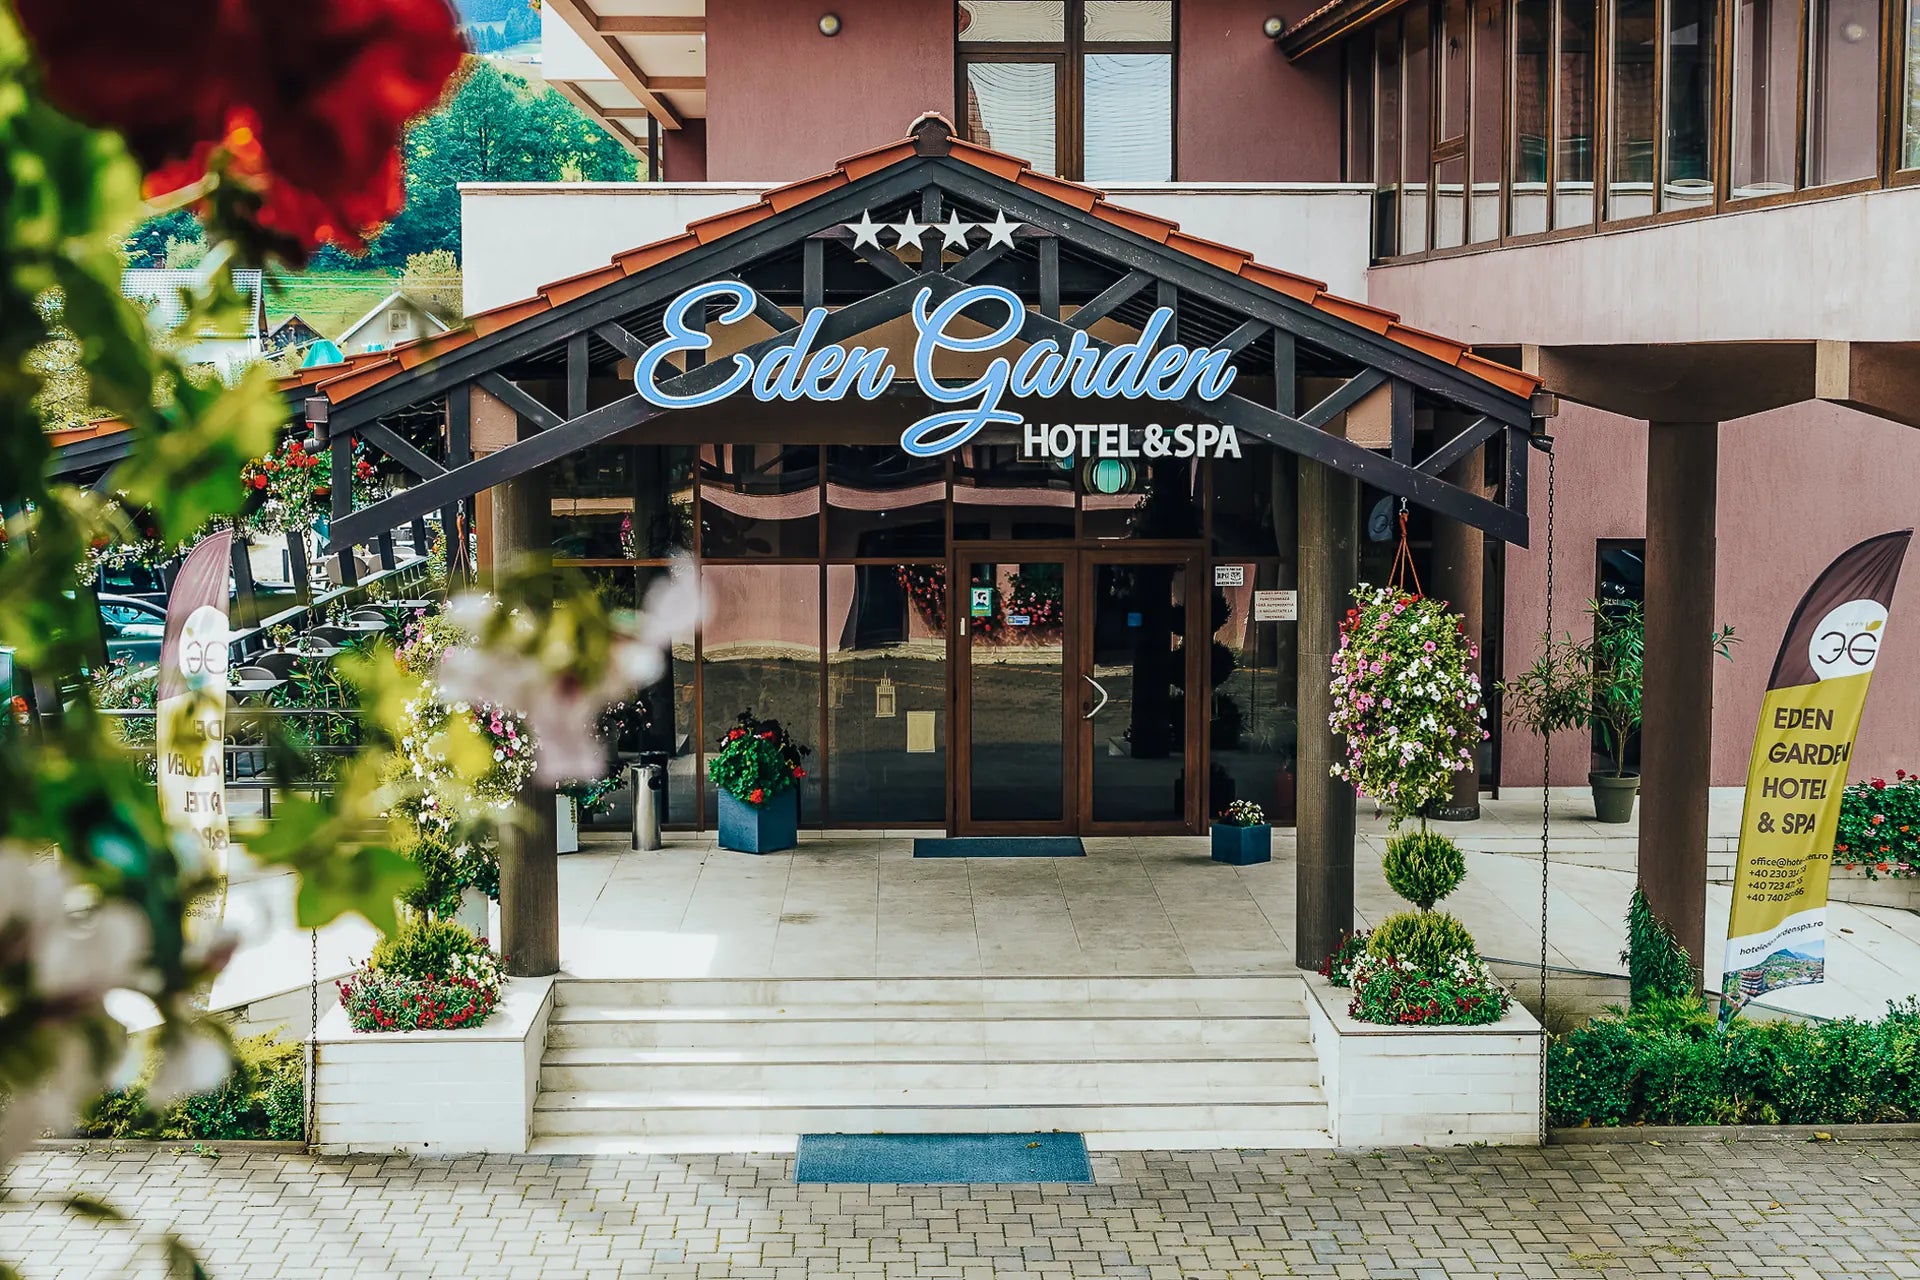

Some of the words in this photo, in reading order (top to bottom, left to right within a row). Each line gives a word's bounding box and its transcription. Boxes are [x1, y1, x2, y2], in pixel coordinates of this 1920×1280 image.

[633, 280, 899, 409] Eden
[900, 284, 1239, 458] Garden
[1773, 707, 1834, 731] EDEN
[1768, 741, 1852, 766] GARDEN
[1762, 777, 1827, 801] HOTEL
[1757, 811, 1775, 834] &
[1781, 813, 1816, 835] SPA
[1747, 881, 1767, 890] +40
[1768, 881, 1784, 890] 723
[1749, 869, 1768, 878] +40
[1769, 869, 1788, 878] 230
[1746, 893, 1765, 902] +40
[1767, 893, 1784, 902] 740
